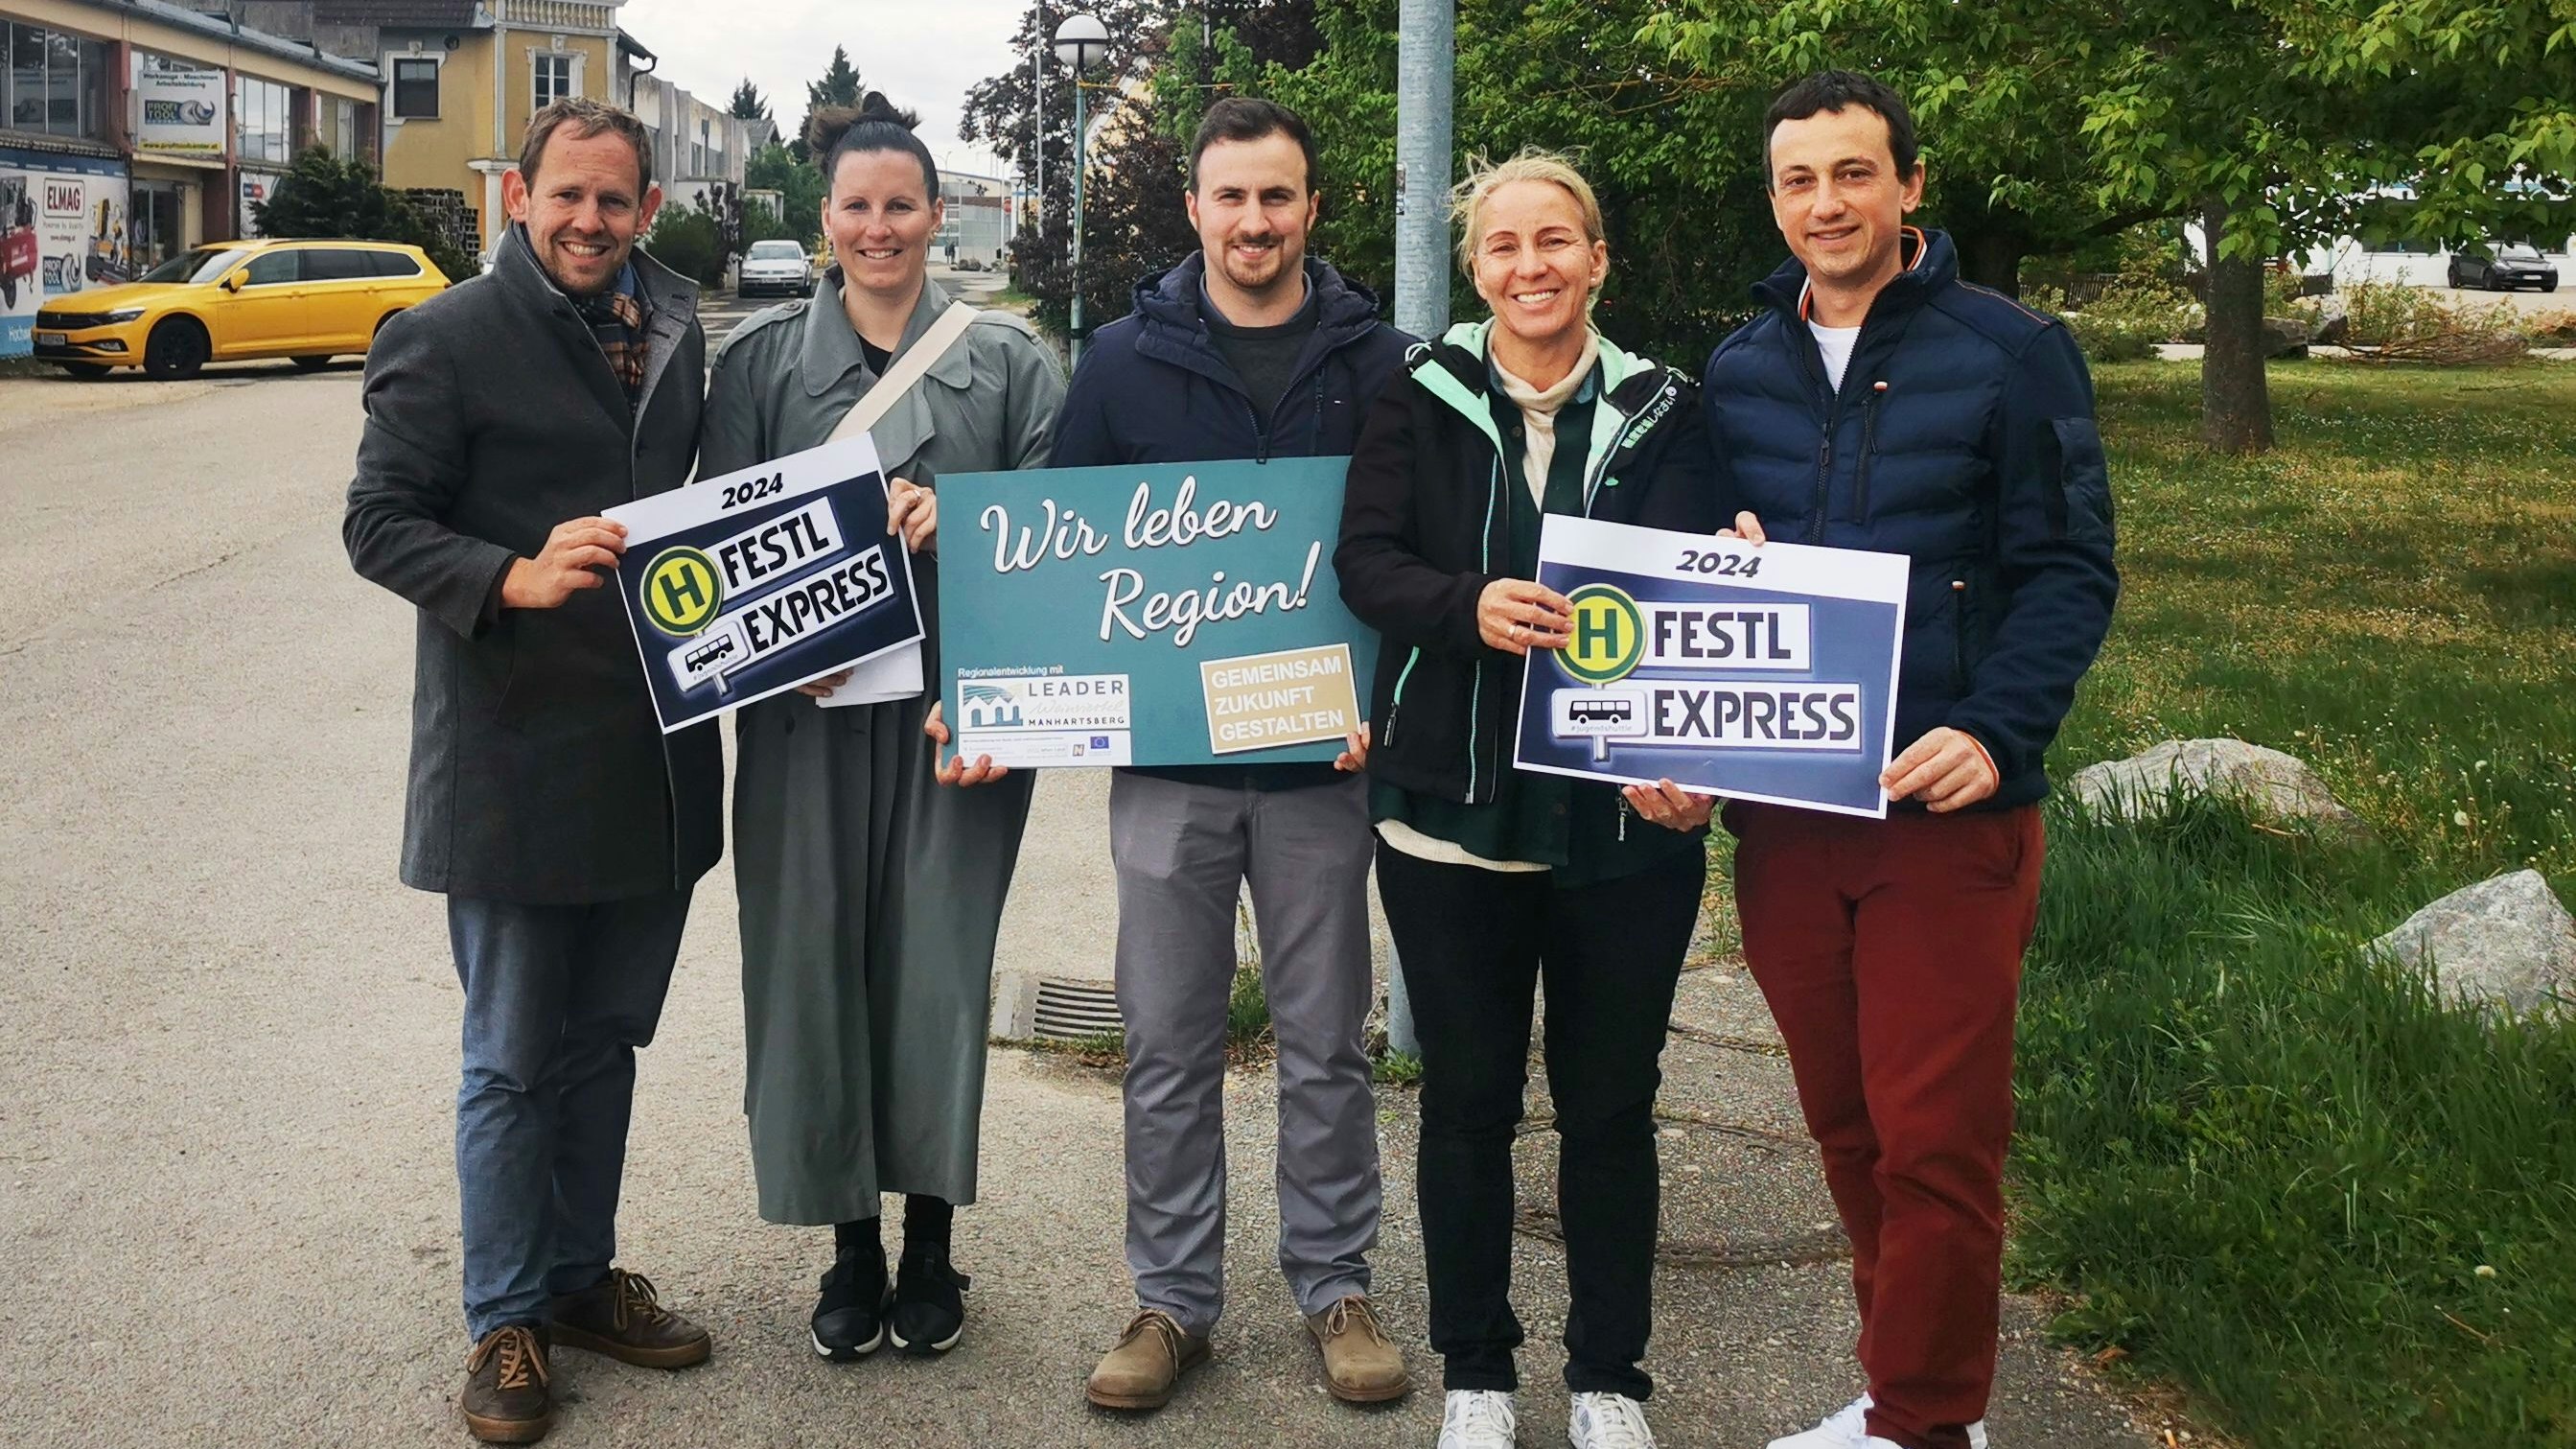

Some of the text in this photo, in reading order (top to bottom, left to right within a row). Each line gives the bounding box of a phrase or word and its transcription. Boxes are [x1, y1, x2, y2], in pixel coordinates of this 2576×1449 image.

[147, 103, 177, 111] PROFI
[148, 110, 175, 119] TOOL
[48, 186, 81, 211] ELMAG
[721, 472, 784, 510] 2024
[980, 475, 1278, 574] Wir leben
[718, 510, 830, 589] FESTL
[1676, 549, 1763, 578] 2024
[658, 563, 707, 619] H
[742, 552, 889, 654] EXPRESS
[1098, 541, 1321, 647] Region!
[1578, 609, 1618, 659] H
[1654, 611, 1792, 660] FESTL
[958, 665, 1064, 678] Regionalentwicklung mit
[1029, 680, 1124, 696] LEADER
[1211, 655, 1342, 689] GEMEINSAM
[1215, 686, 1315, 715] ZUKUNFT
[1654, 689, 1855, 741] EXPRESS
[1028, 716, 1126, 727] MANHARTSBERG
[1218, 710, 1344, 742] GESTALTEN
